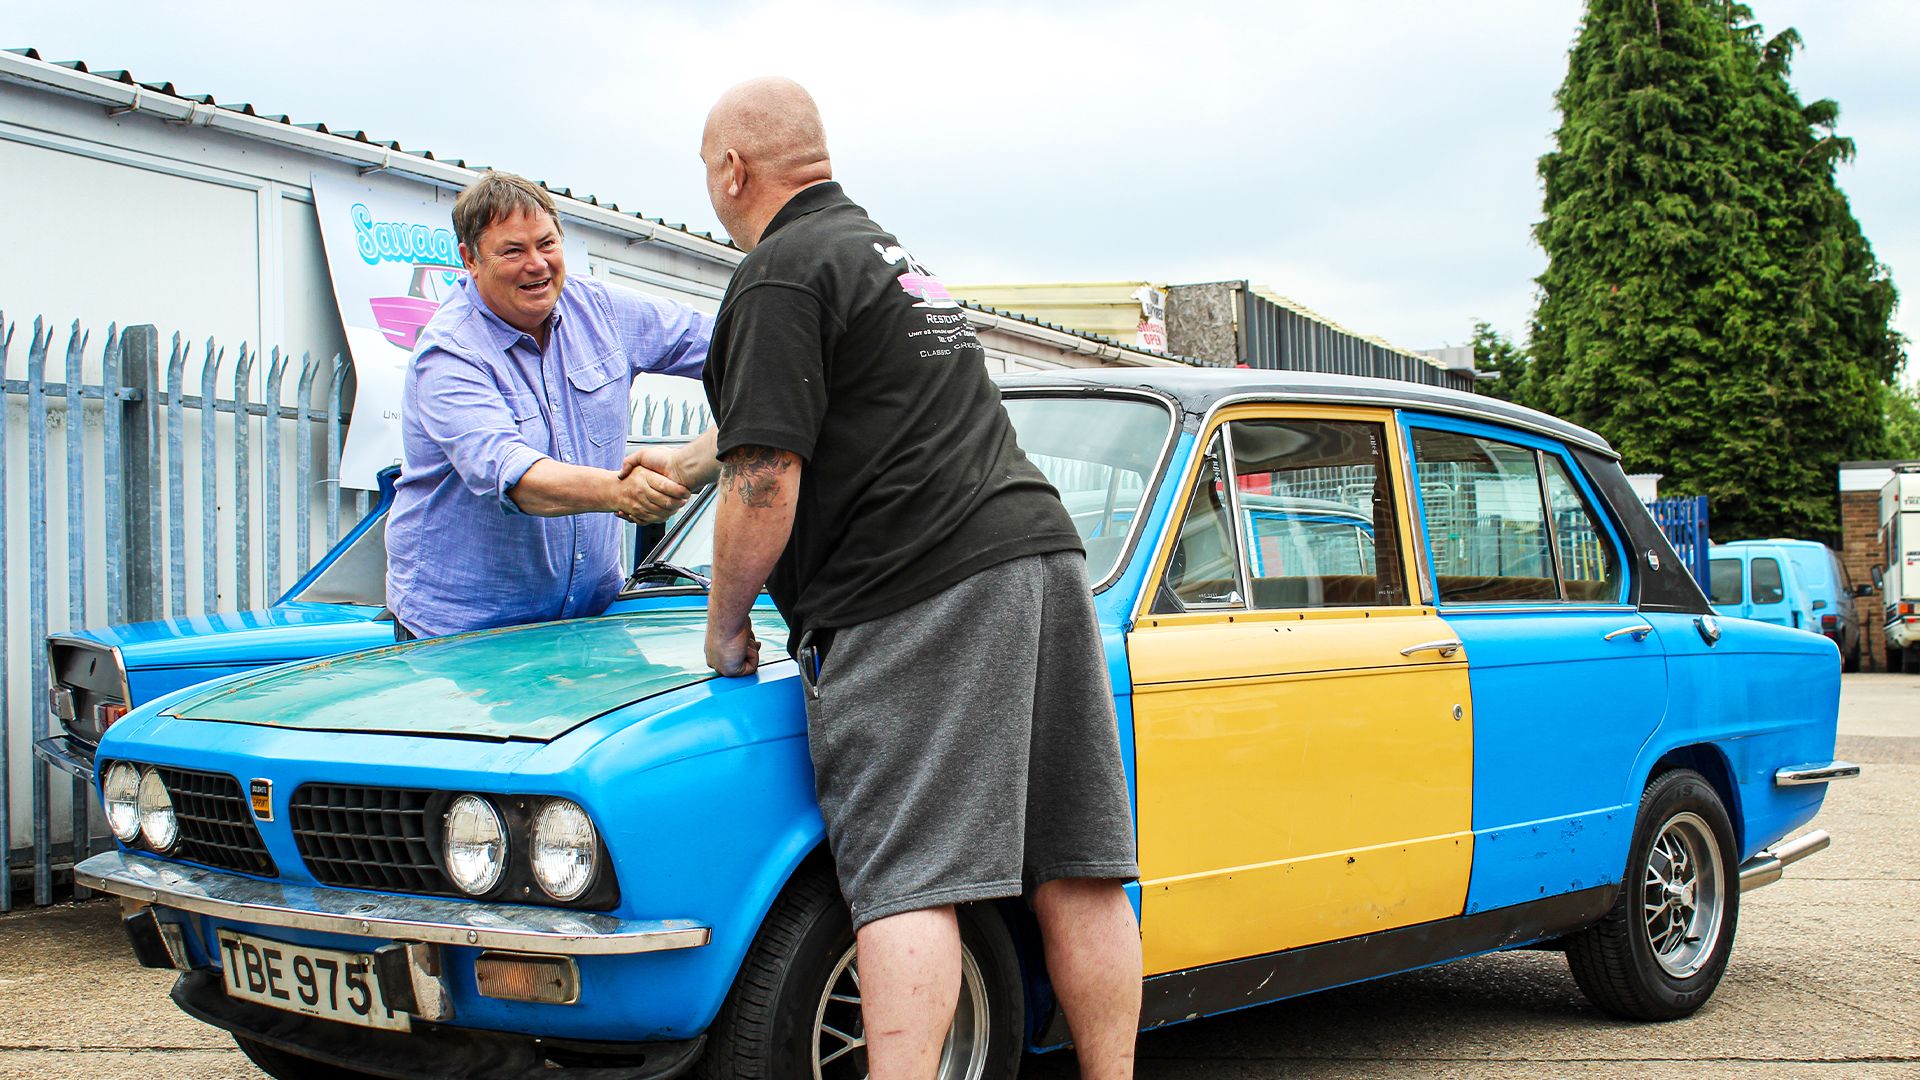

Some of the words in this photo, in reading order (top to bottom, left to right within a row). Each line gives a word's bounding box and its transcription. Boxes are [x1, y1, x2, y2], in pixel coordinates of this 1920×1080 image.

[920, 349, 951, 358] CLASSIC
[383, 409, 402, 420] UNI
[221, 938, 290, 1001] TBE
